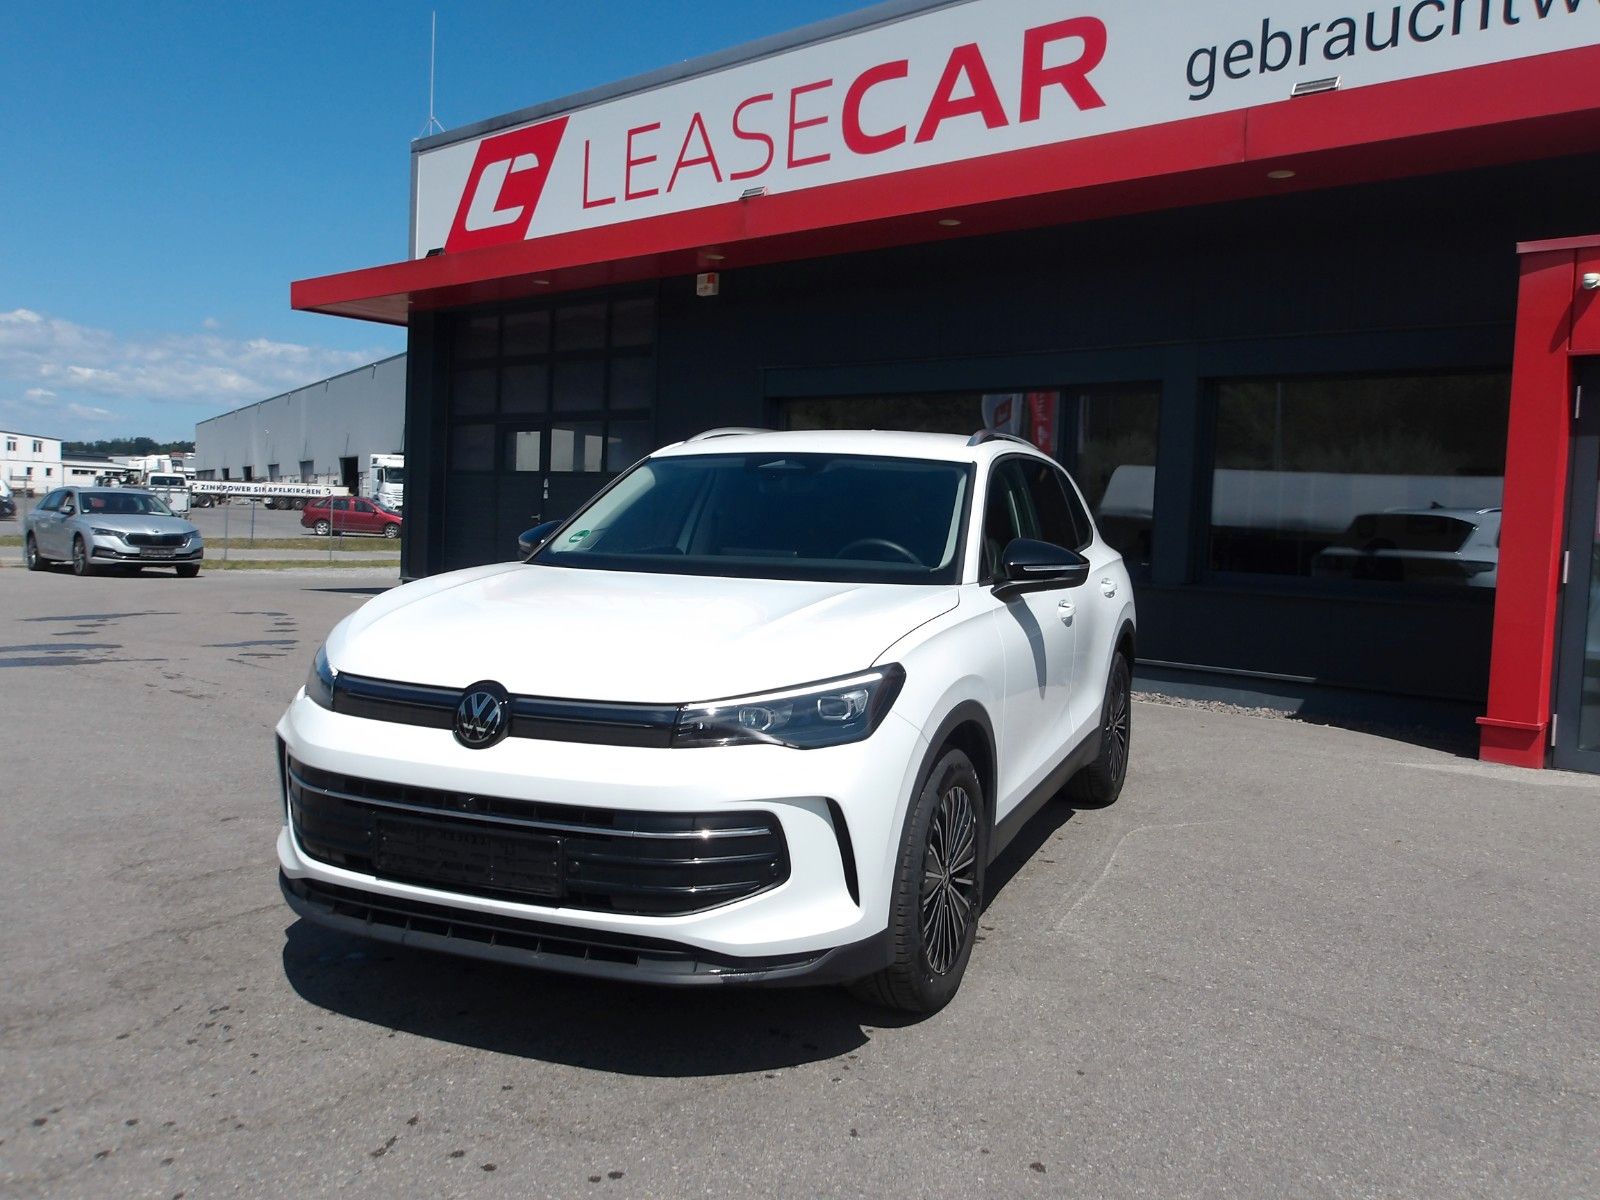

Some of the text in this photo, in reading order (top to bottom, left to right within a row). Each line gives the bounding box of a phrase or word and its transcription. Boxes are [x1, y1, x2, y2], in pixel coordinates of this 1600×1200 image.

[1186, 0, 1600, 101] gebrauchtw
[582, 16, 1107, 209] LEASECAR
[200, 484, 251, 493] ZINKPOWER
